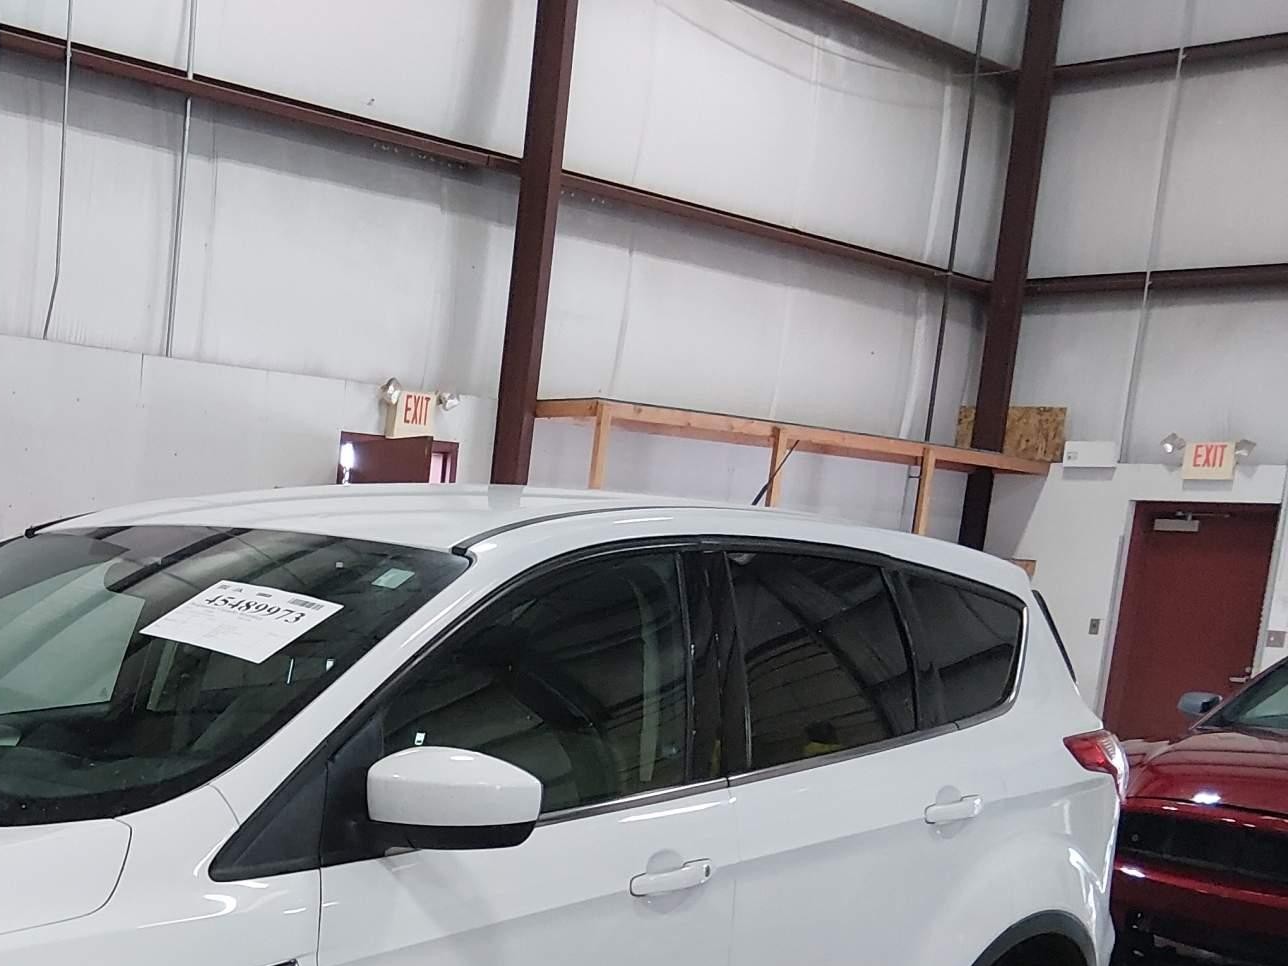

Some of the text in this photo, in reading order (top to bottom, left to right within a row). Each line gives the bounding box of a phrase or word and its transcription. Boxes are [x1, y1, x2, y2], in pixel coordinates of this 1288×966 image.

[403, 395, 431, 426] EXIT
[1192, 444, 1228, 468] EXIT
[204, 595, 306, 623] 45489973
